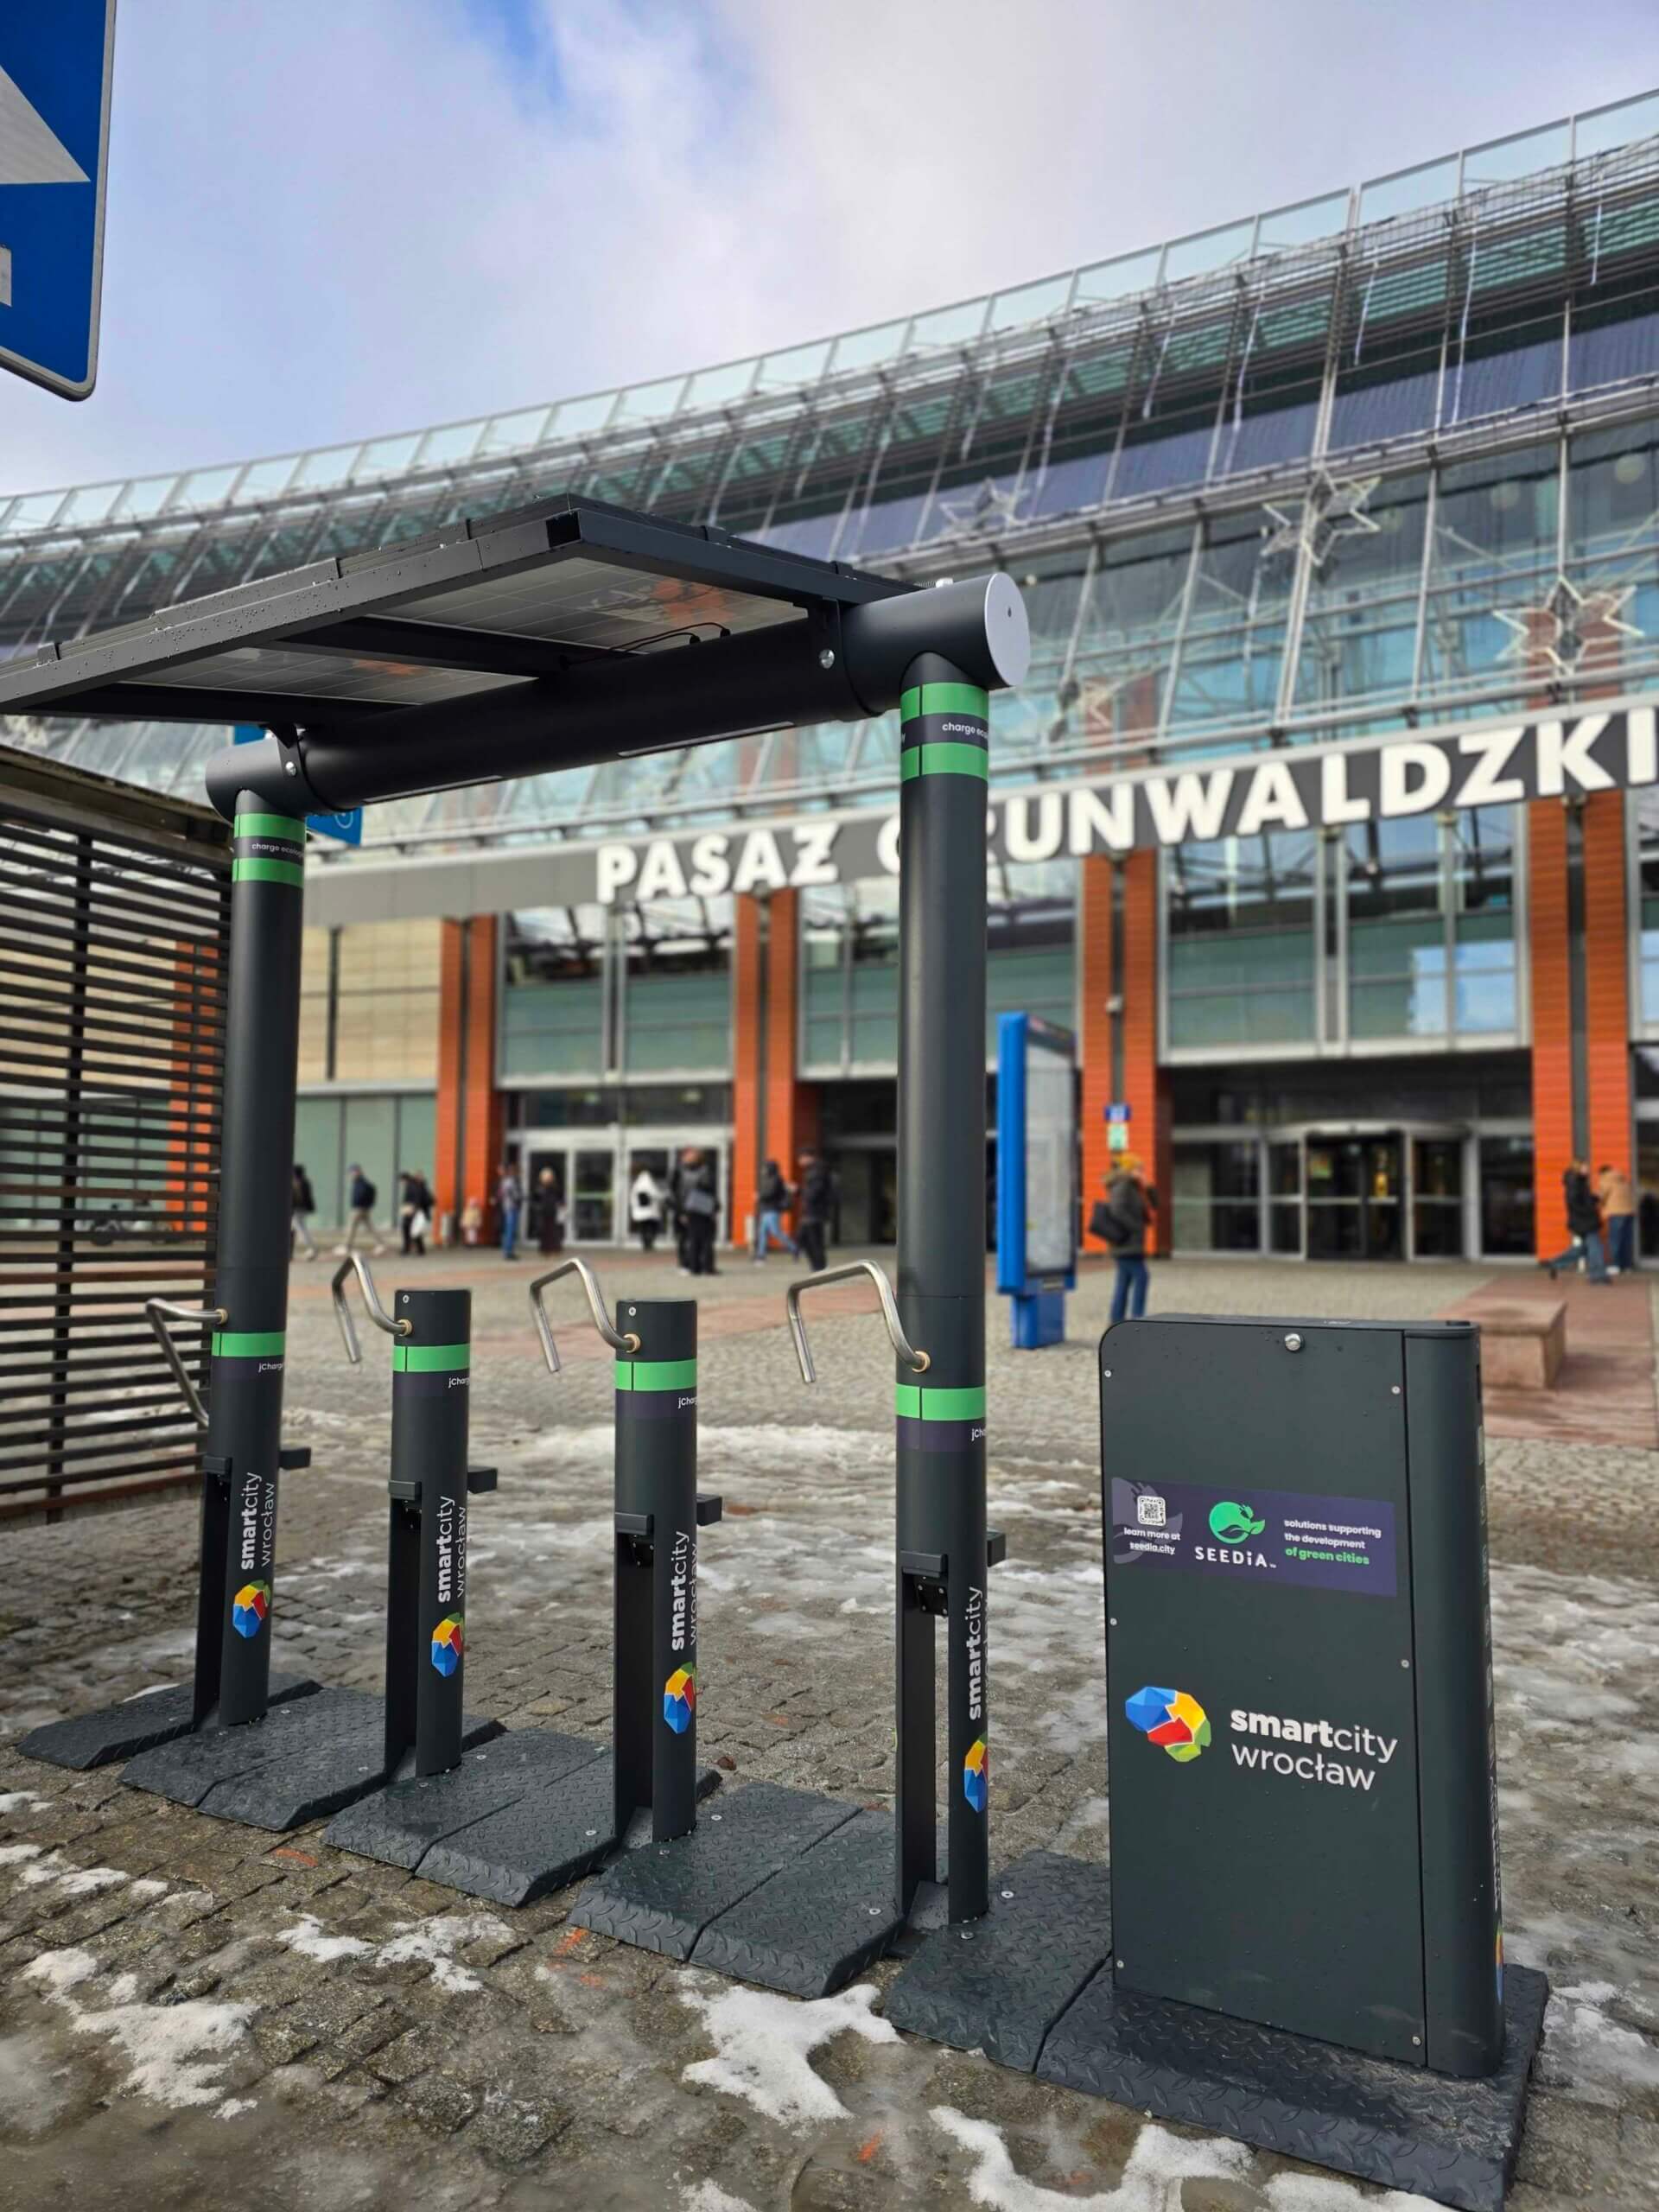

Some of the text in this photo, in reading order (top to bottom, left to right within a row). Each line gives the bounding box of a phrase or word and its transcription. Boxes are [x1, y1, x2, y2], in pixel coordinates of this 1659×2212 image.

[942, 721, 976, 735] charge
[876, 707, 1657, 875] UNWALDZKI
[251, 842, 279, 853] charge
[241, 1471, 263, 1570] smartcity
[1123, 1527, 1146, 1537] learn
[1147, 1530, 1170, 1540] more
[1284, 1519, 1382, 1539] solutions supporting
[1284, 1532, 1366, 1549] the development
[435, 1496, 456, 1603] smartcity
[1285, 1547, 1370, 1565] of green cities
[671, 1530, 690, 1651] smartcity
[966, 1586, 983, 1722] smartcity
[1230, 1708, 1398, 1764] smartcity
[1230, 1742, 1376, 1791] wrocław
